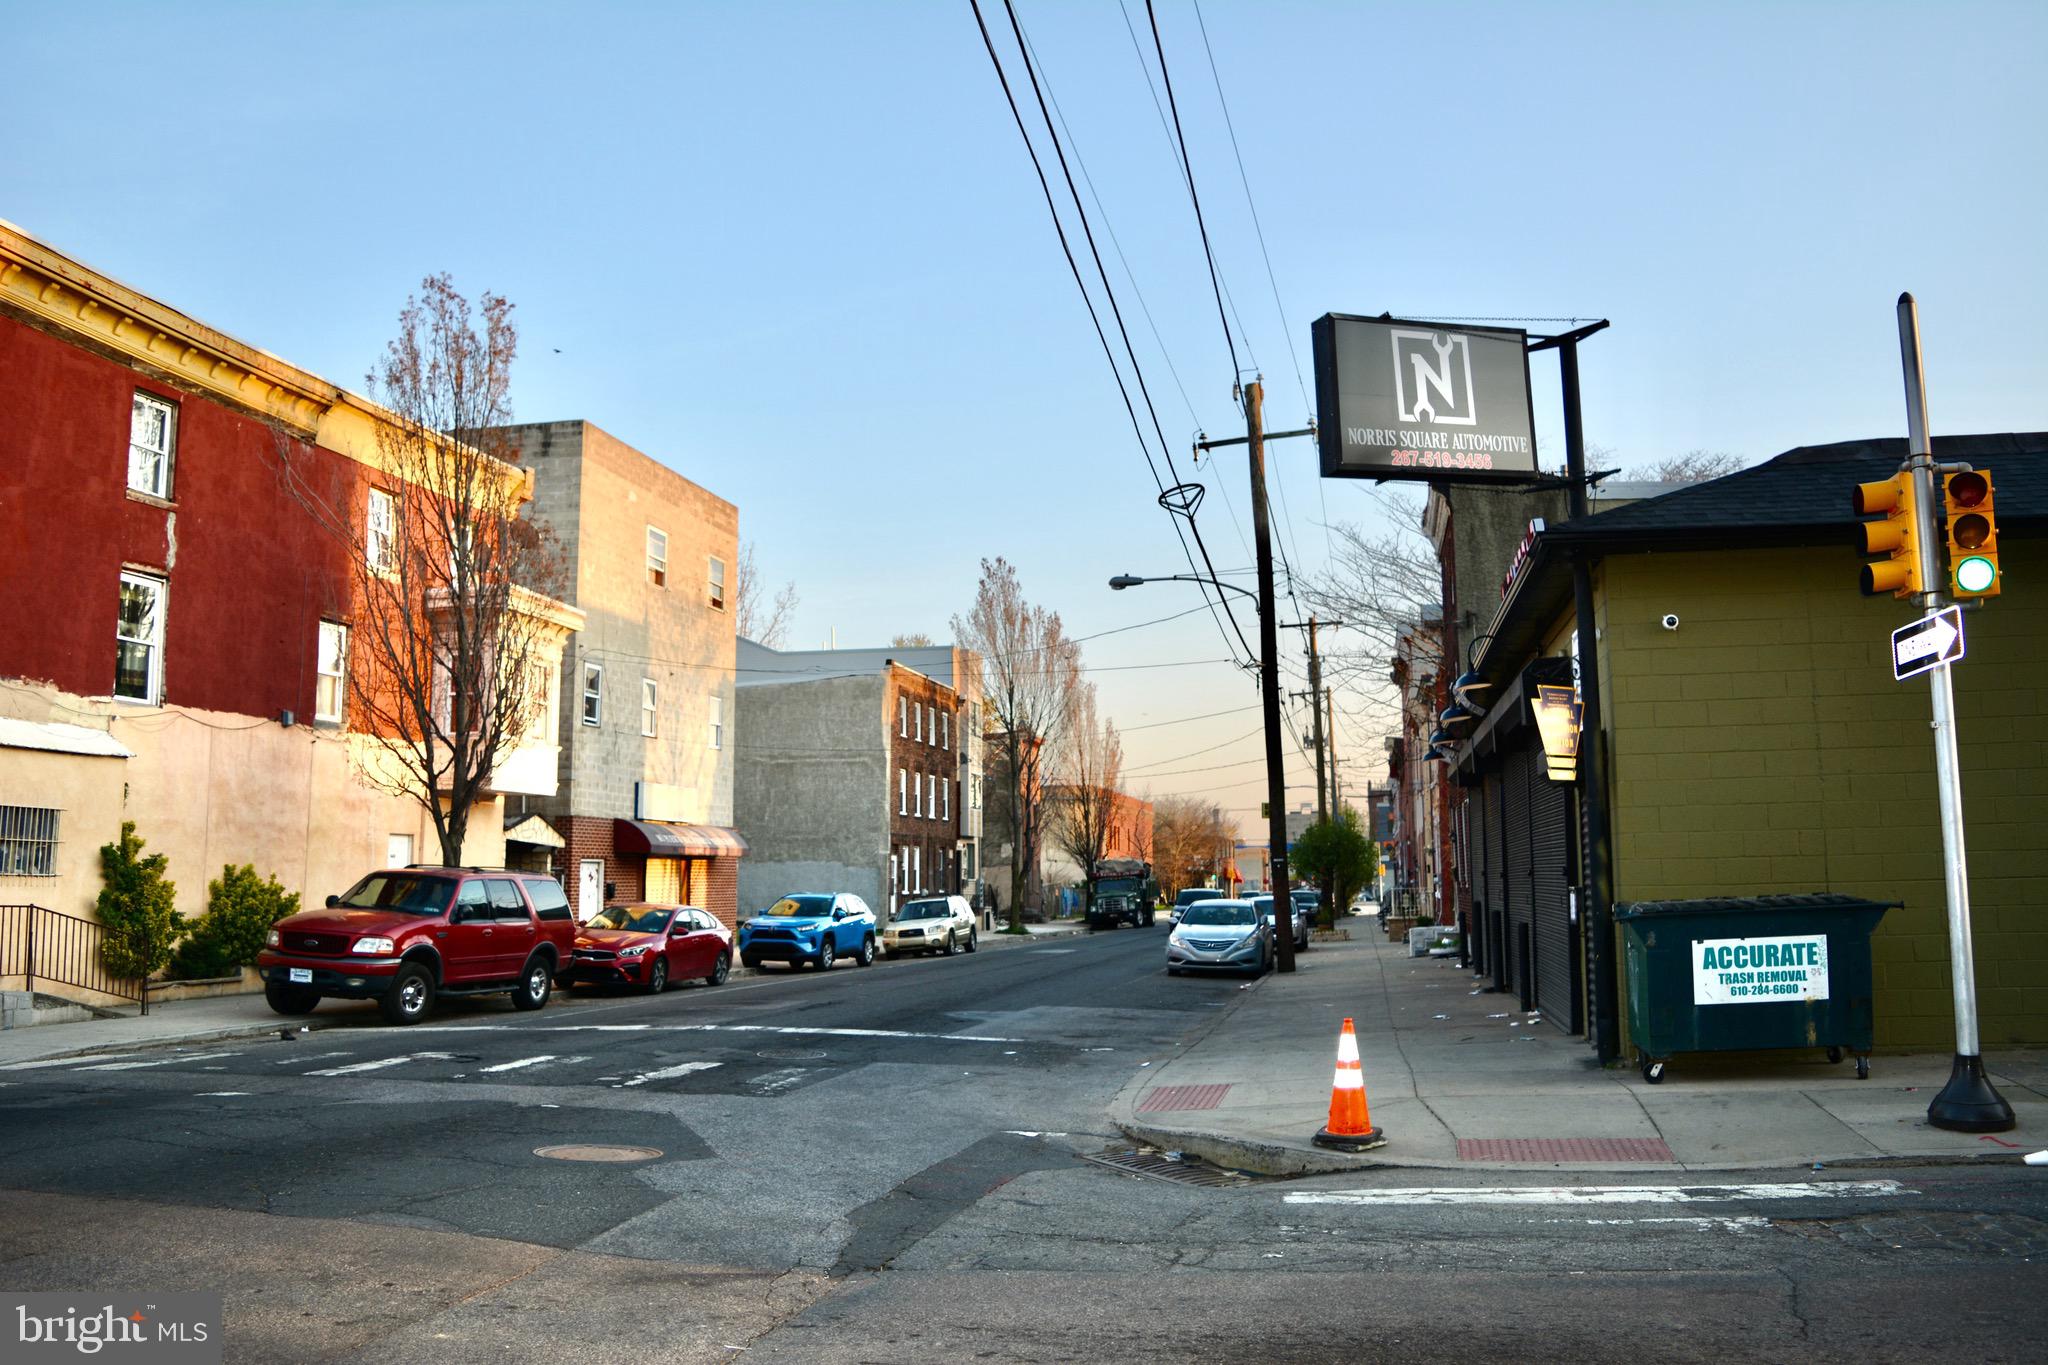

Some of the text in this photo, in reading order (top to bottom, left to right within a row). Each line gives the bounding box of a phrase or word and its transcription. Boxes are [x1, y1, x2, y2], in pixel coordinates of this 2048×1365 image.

[1348, 428, 1528, 453] NORRIS SQUARE AUTOMOTIVE
[1391, 449, 1493, 469] 267-519-3456
[1702, 942, 1819, 970] ACCURATE
[1718, 972, 1755, 985] TRASH
[1757, 970, 1808, 984] REMOVAL
[1730, 984, 1799, 996] 610-284-6600
